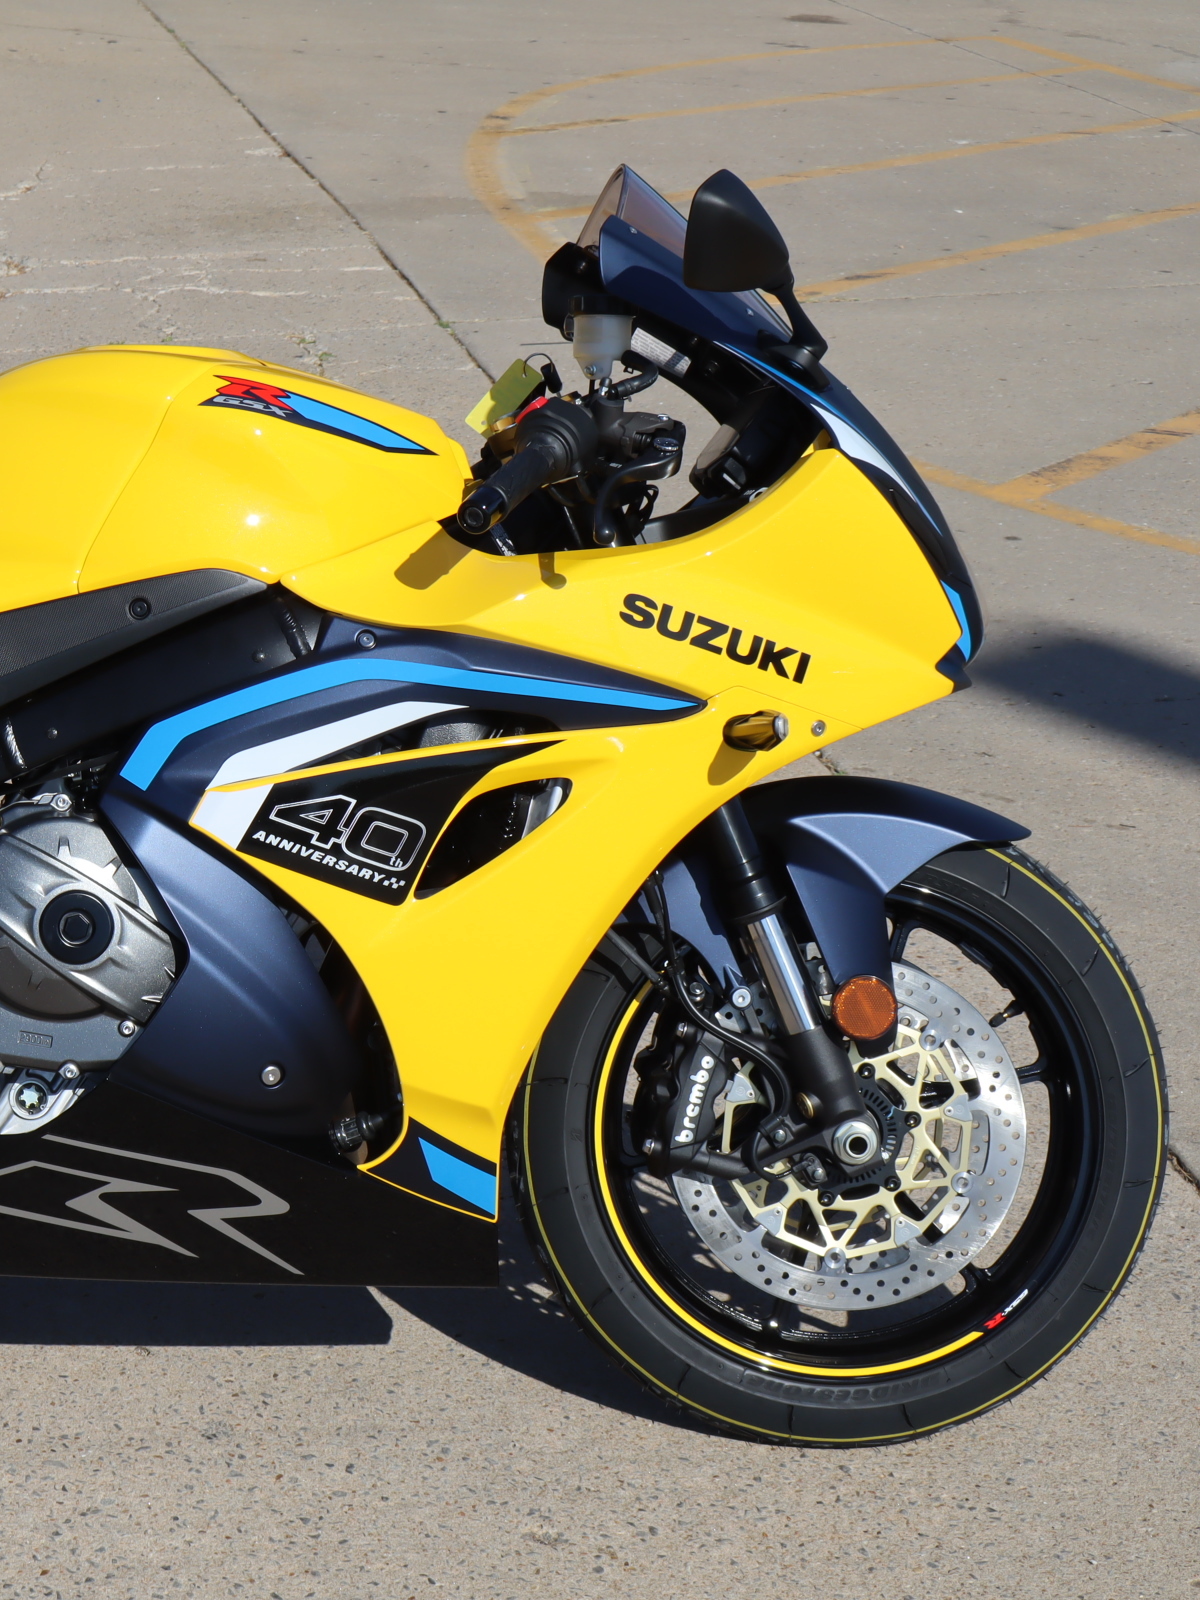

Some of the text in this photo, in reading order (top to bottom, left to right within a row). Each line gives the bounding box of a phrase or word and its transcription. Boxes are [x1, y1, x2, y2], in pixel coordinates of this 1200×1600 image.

[619, 593, 812, 685] SUZUKI
[252, 830, 387, 884] ANNIVERSARY
[674, 1056, 715, 1143] brembo
